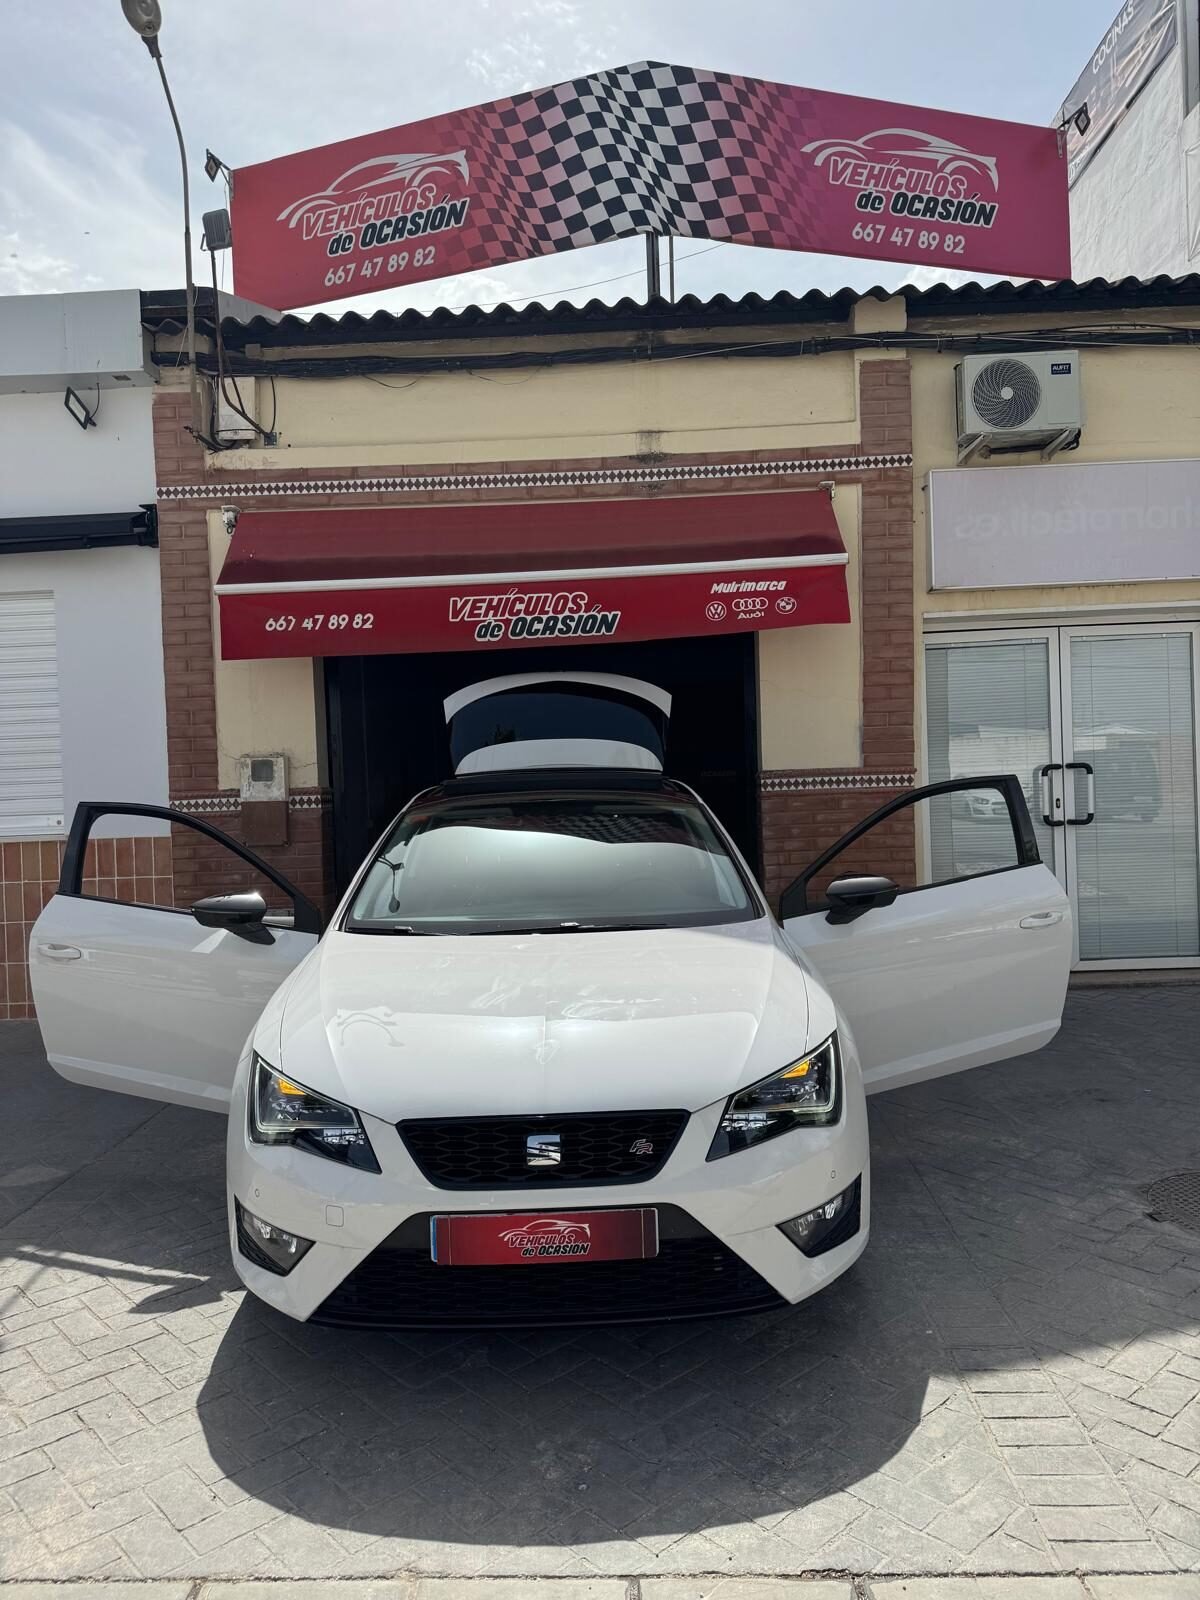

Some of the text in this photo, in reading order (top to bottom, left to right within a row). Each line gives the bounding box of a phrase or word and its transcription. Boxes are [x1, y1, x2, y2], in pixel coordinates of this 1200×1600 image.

[829, 156, 968, 200] VEHÍCULOS
[303, 183, 437, 240] VEHÍCULOS
[327, 194, 470, 257] de OCASIÓN
[856, 189, 999, 228] de OCASIÓN
[852, 222, 966, 254] 667 47 89 82
[324, 246, 436, 287] 667 47 89 82
[265, 613, 374, 632] 667 47 89 82
[449, 588, 588, 621] VEHÍCULOS
[475, 604, 621, 642] de OCASIÓN
[737, 611, 765, 620] Audi
[521, 1247, 536, 1257] de
